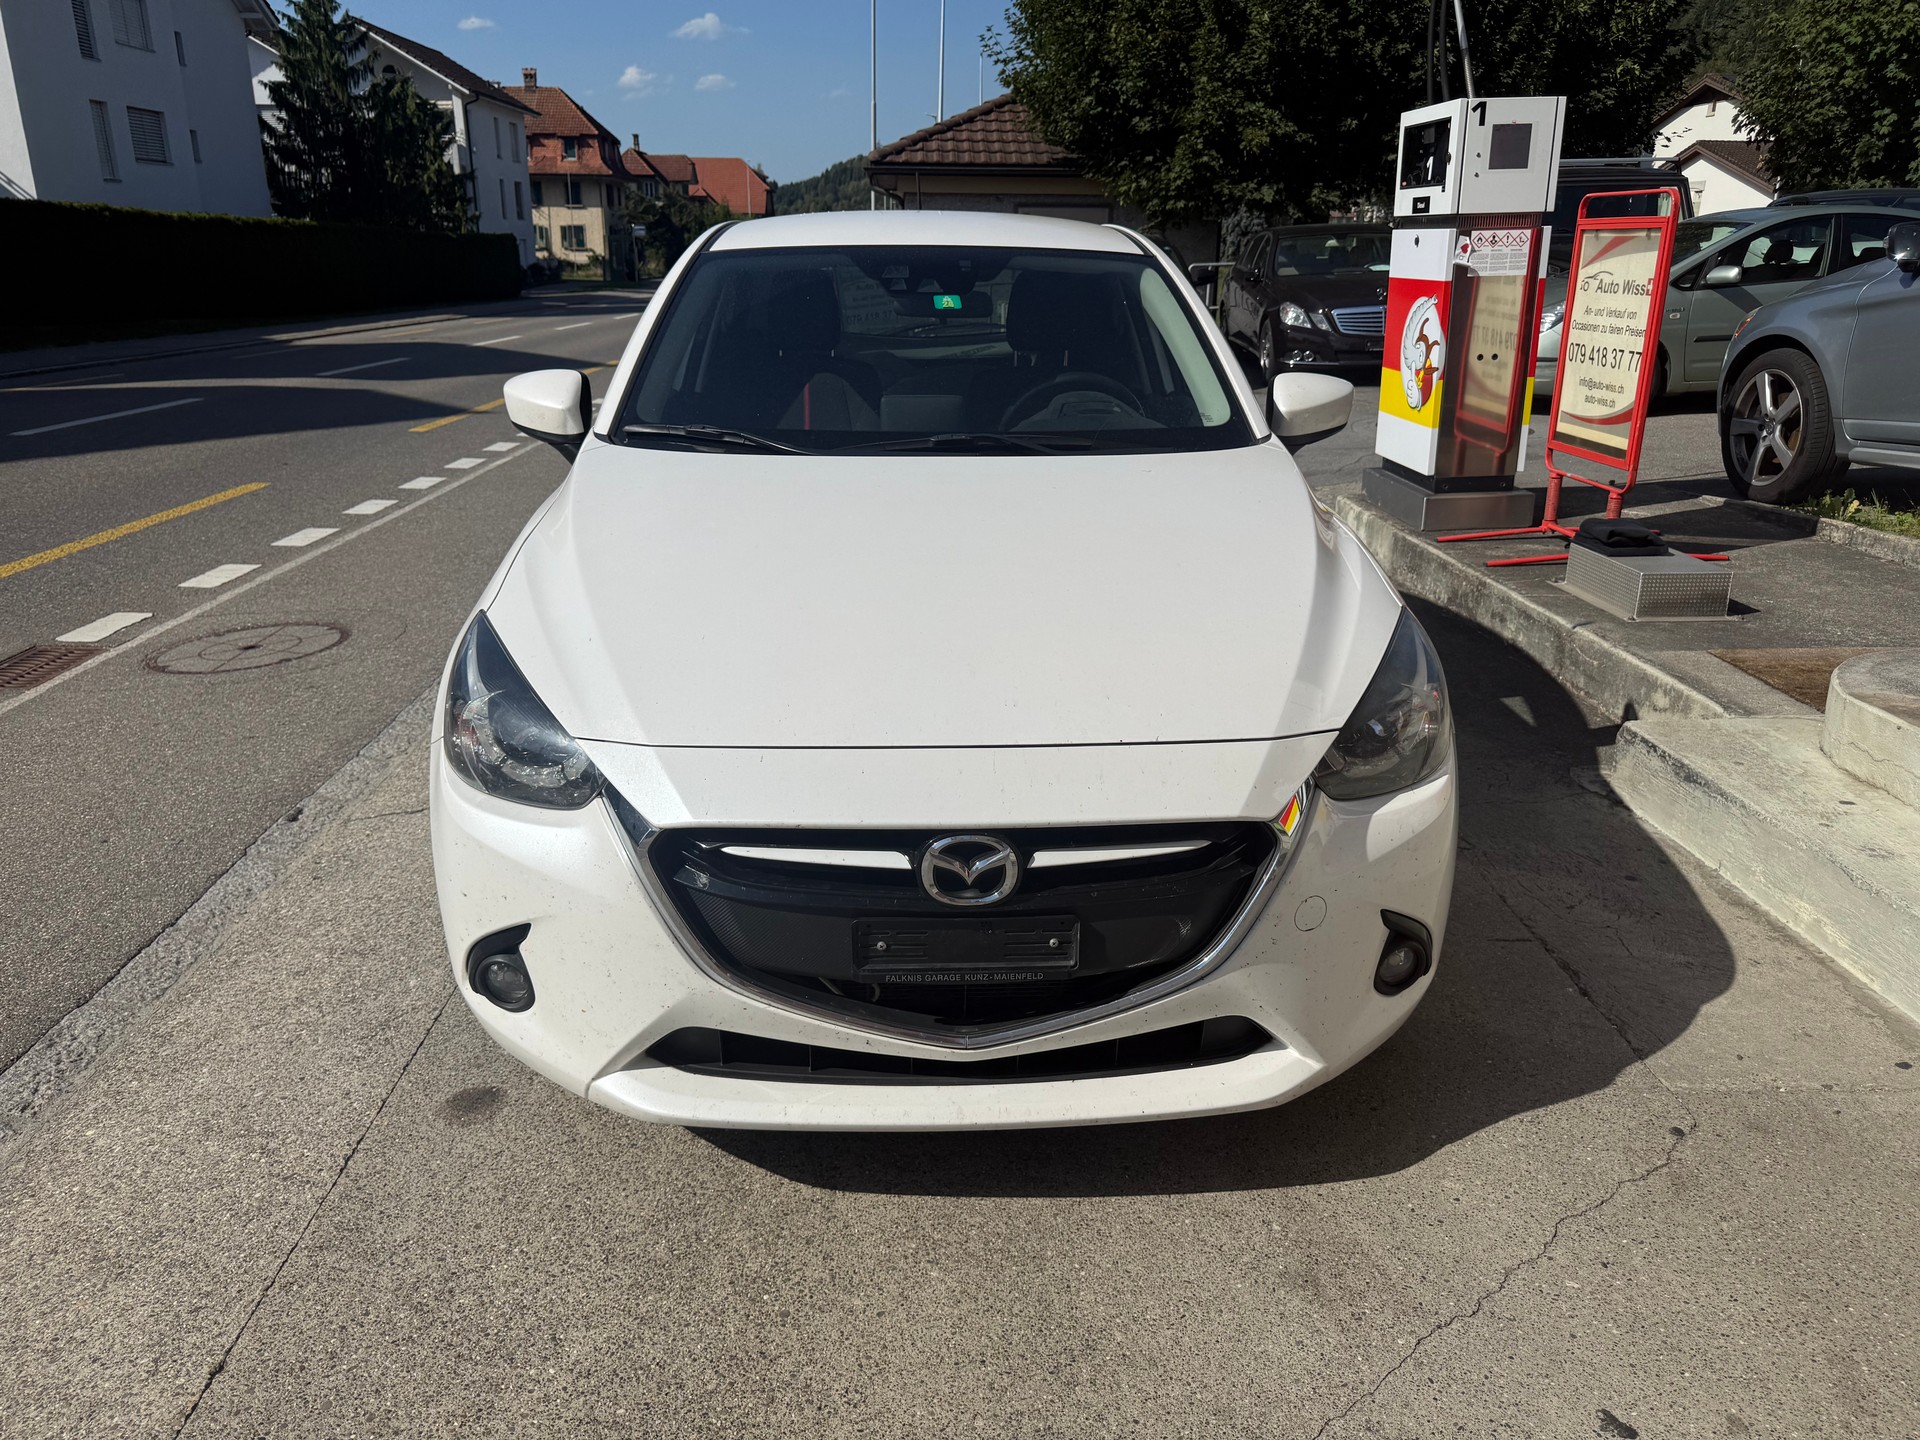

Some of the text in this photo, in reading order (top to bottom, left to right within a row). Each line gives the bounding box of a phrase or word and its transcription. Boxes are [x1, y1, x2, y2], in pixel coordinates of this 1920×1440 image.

[1471, 101, 1487, 126] 1
[1426, 156, 1434, 181] 1
[1595, 278, 1646, 296] Auto Wiss
[1583, 305, 1637, 320] An- und Verkauf von
[1571, 319, 1600, 333] Occasionen
[1600, 324, 1608, 334] zu
[1608, 323, 1623, 335] fairen
[1568, 342, 1643, 373] 079 418 37 77
[1579, 376, 1624, 394] info@auto-wiss.ch
[1584, 394, 1616, 409] auto-wiss.ch
[885, 974, 922, 982] FALKNIS
[924, 973, 961, 982] GARAGE
